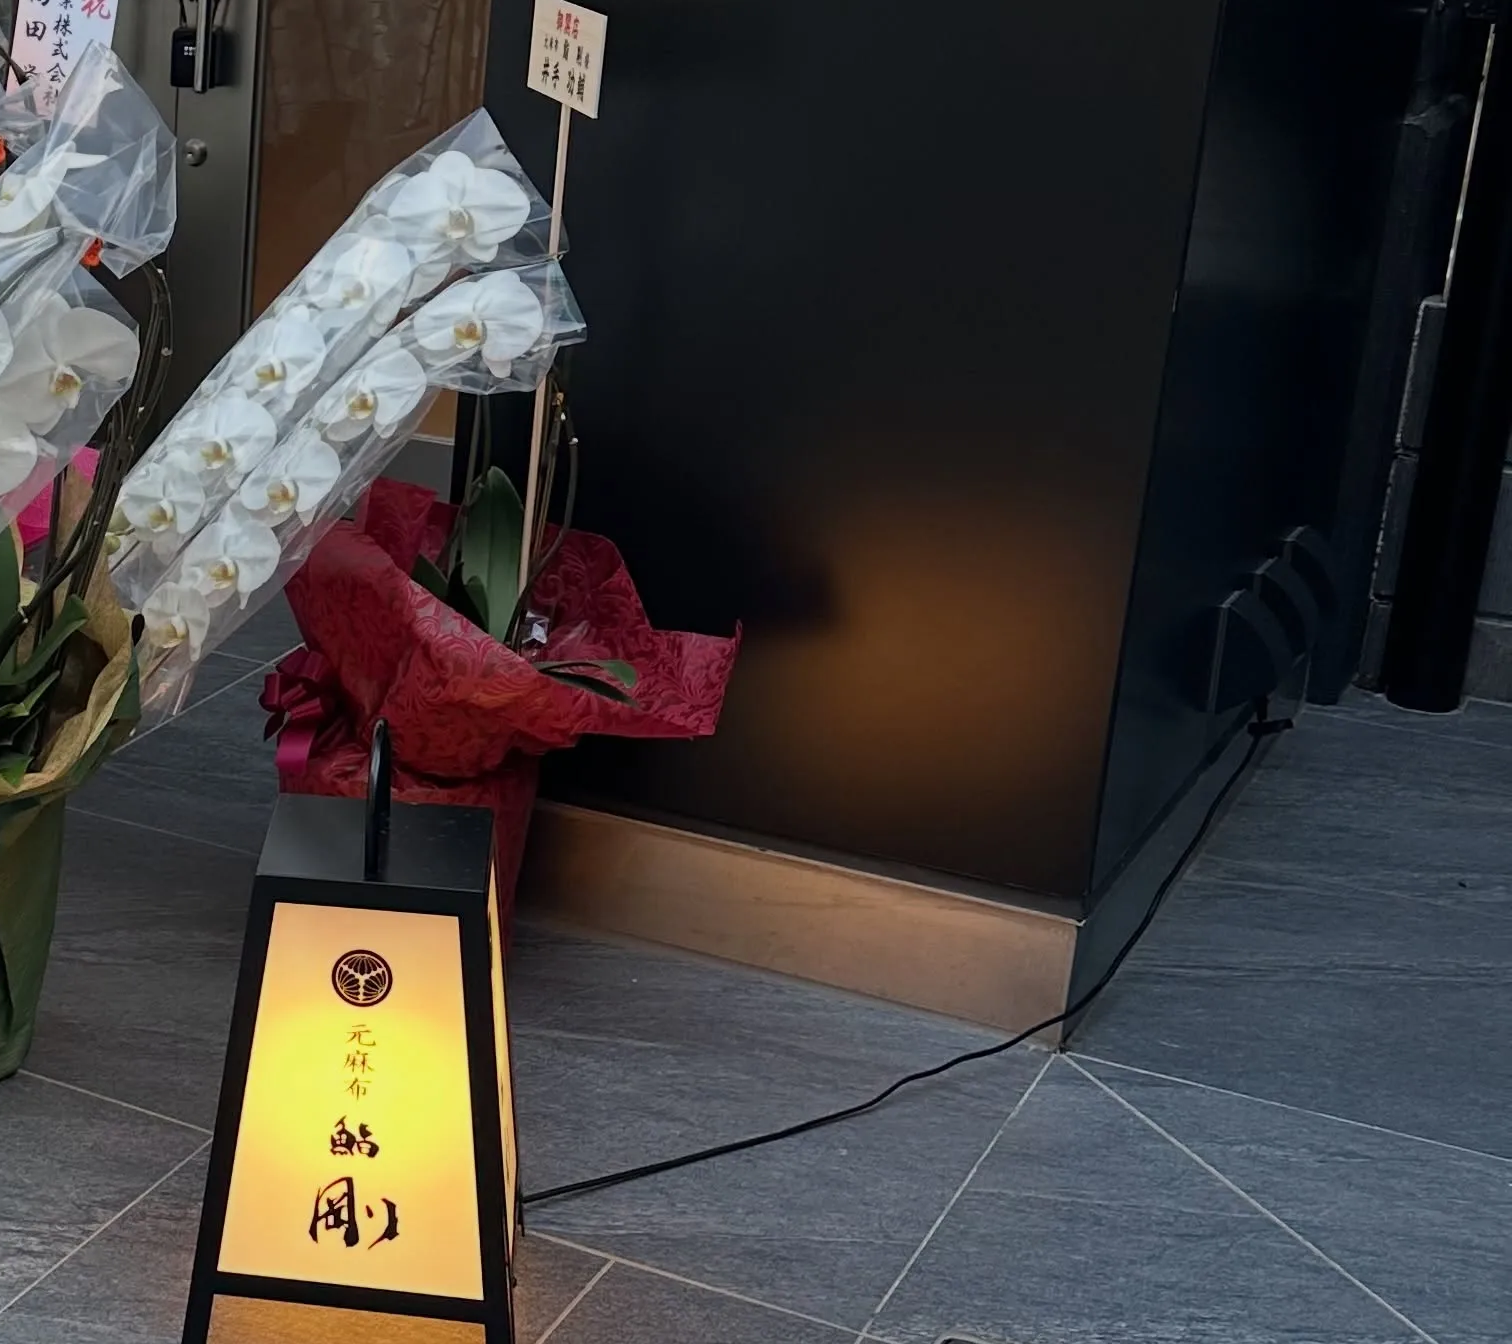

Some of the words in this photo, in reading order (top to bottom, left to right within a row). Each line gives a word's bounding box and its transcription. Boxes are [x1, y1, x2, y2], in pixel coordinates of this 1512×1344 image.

[344, 1024, 377, 1102] 元麻布
[308, 1176, 400, 1250] 剛
